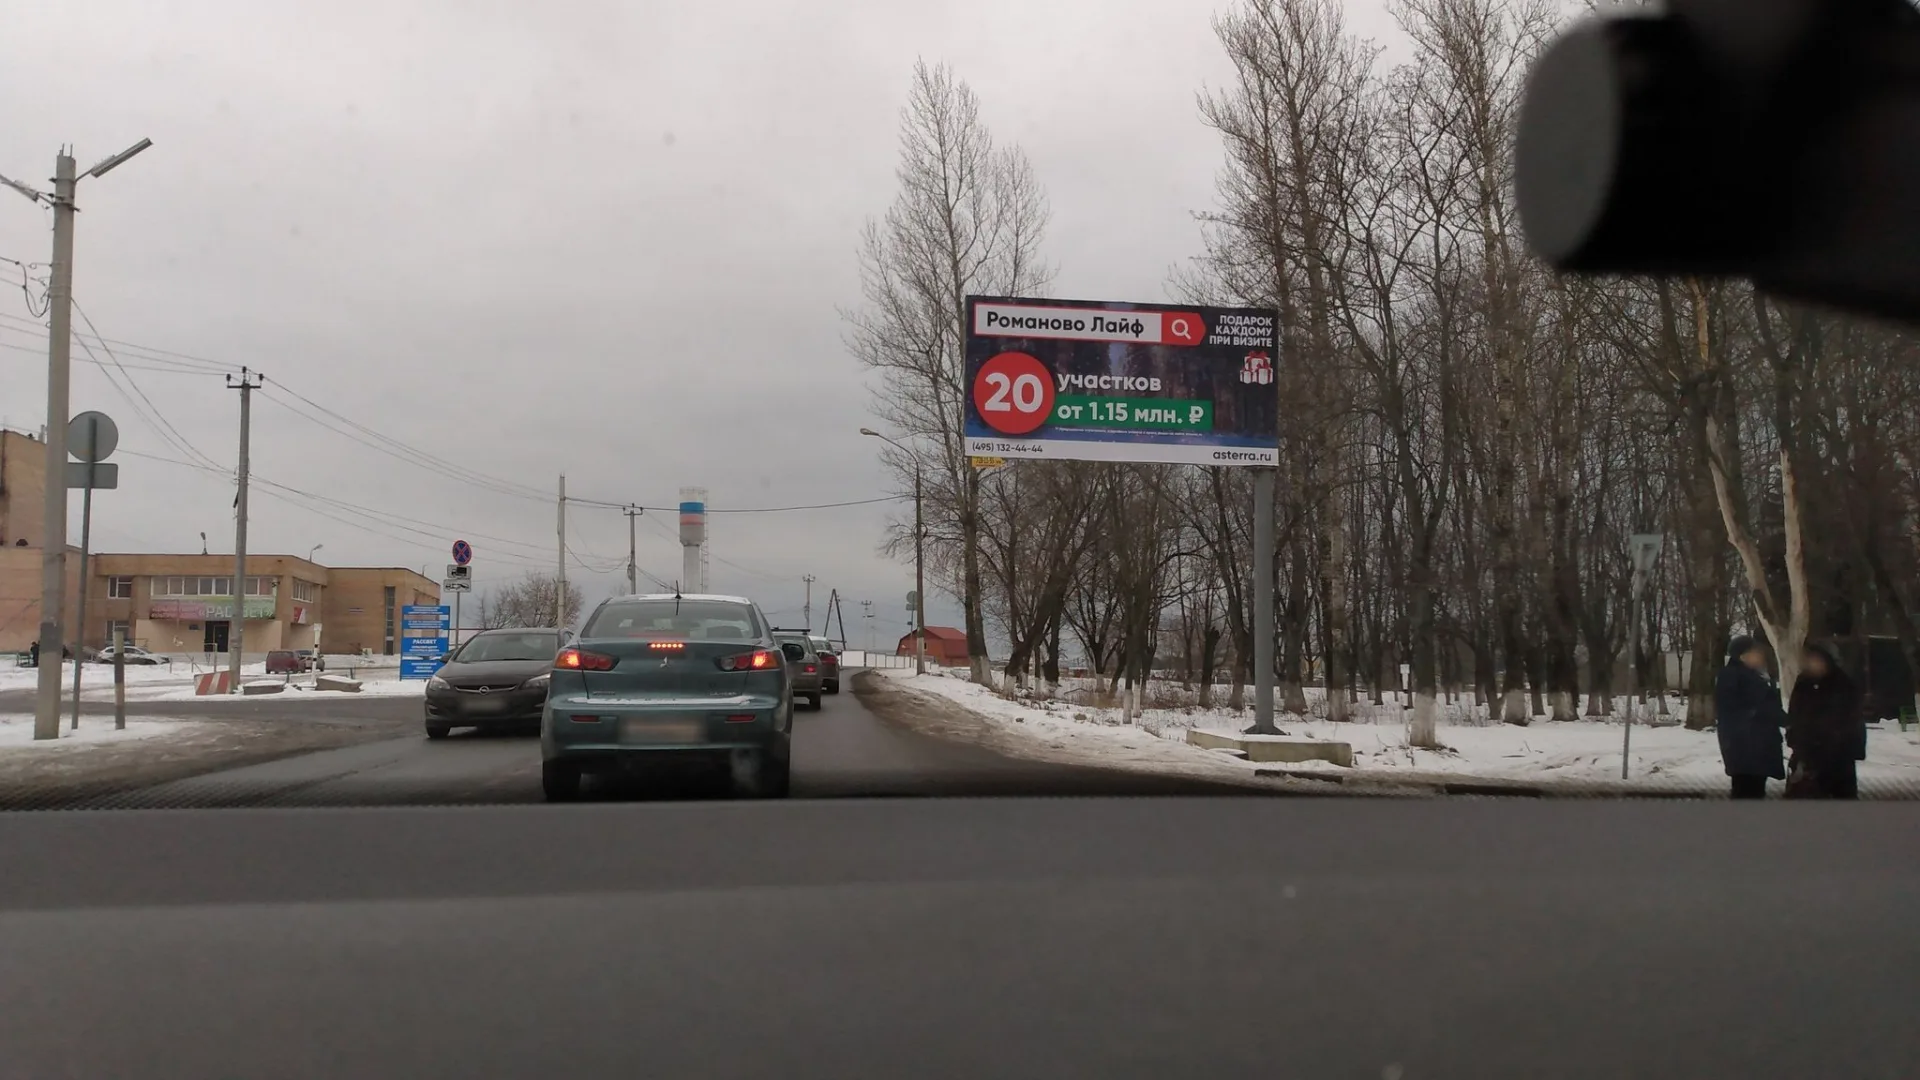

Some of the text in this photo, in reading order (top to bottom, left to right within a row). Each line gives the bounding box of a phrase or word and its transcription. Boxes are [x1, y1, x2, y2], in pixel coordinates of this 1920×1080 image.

[986, 311, 1145, 337] Романово Лайф
[1219, 314, 1273, 326] ПОДАРОК
[1215, 325, 1273, 337] КАЖДОМУ
[1209, 335, 1273, 348] ПРИ ВИЗИТЕ
[1057, 372, 1162, 392] участков
[984, 372, 1043, 414] 20
[1057, 406, 1083, 420] от
[1088, 401, 1128, 422] 1.15
[1134, 409, 1183, 424] млн.
[971, 441, 1044, 453] (495) 132-44-44
[1212, 449, 1273, 463] asterra.ru
